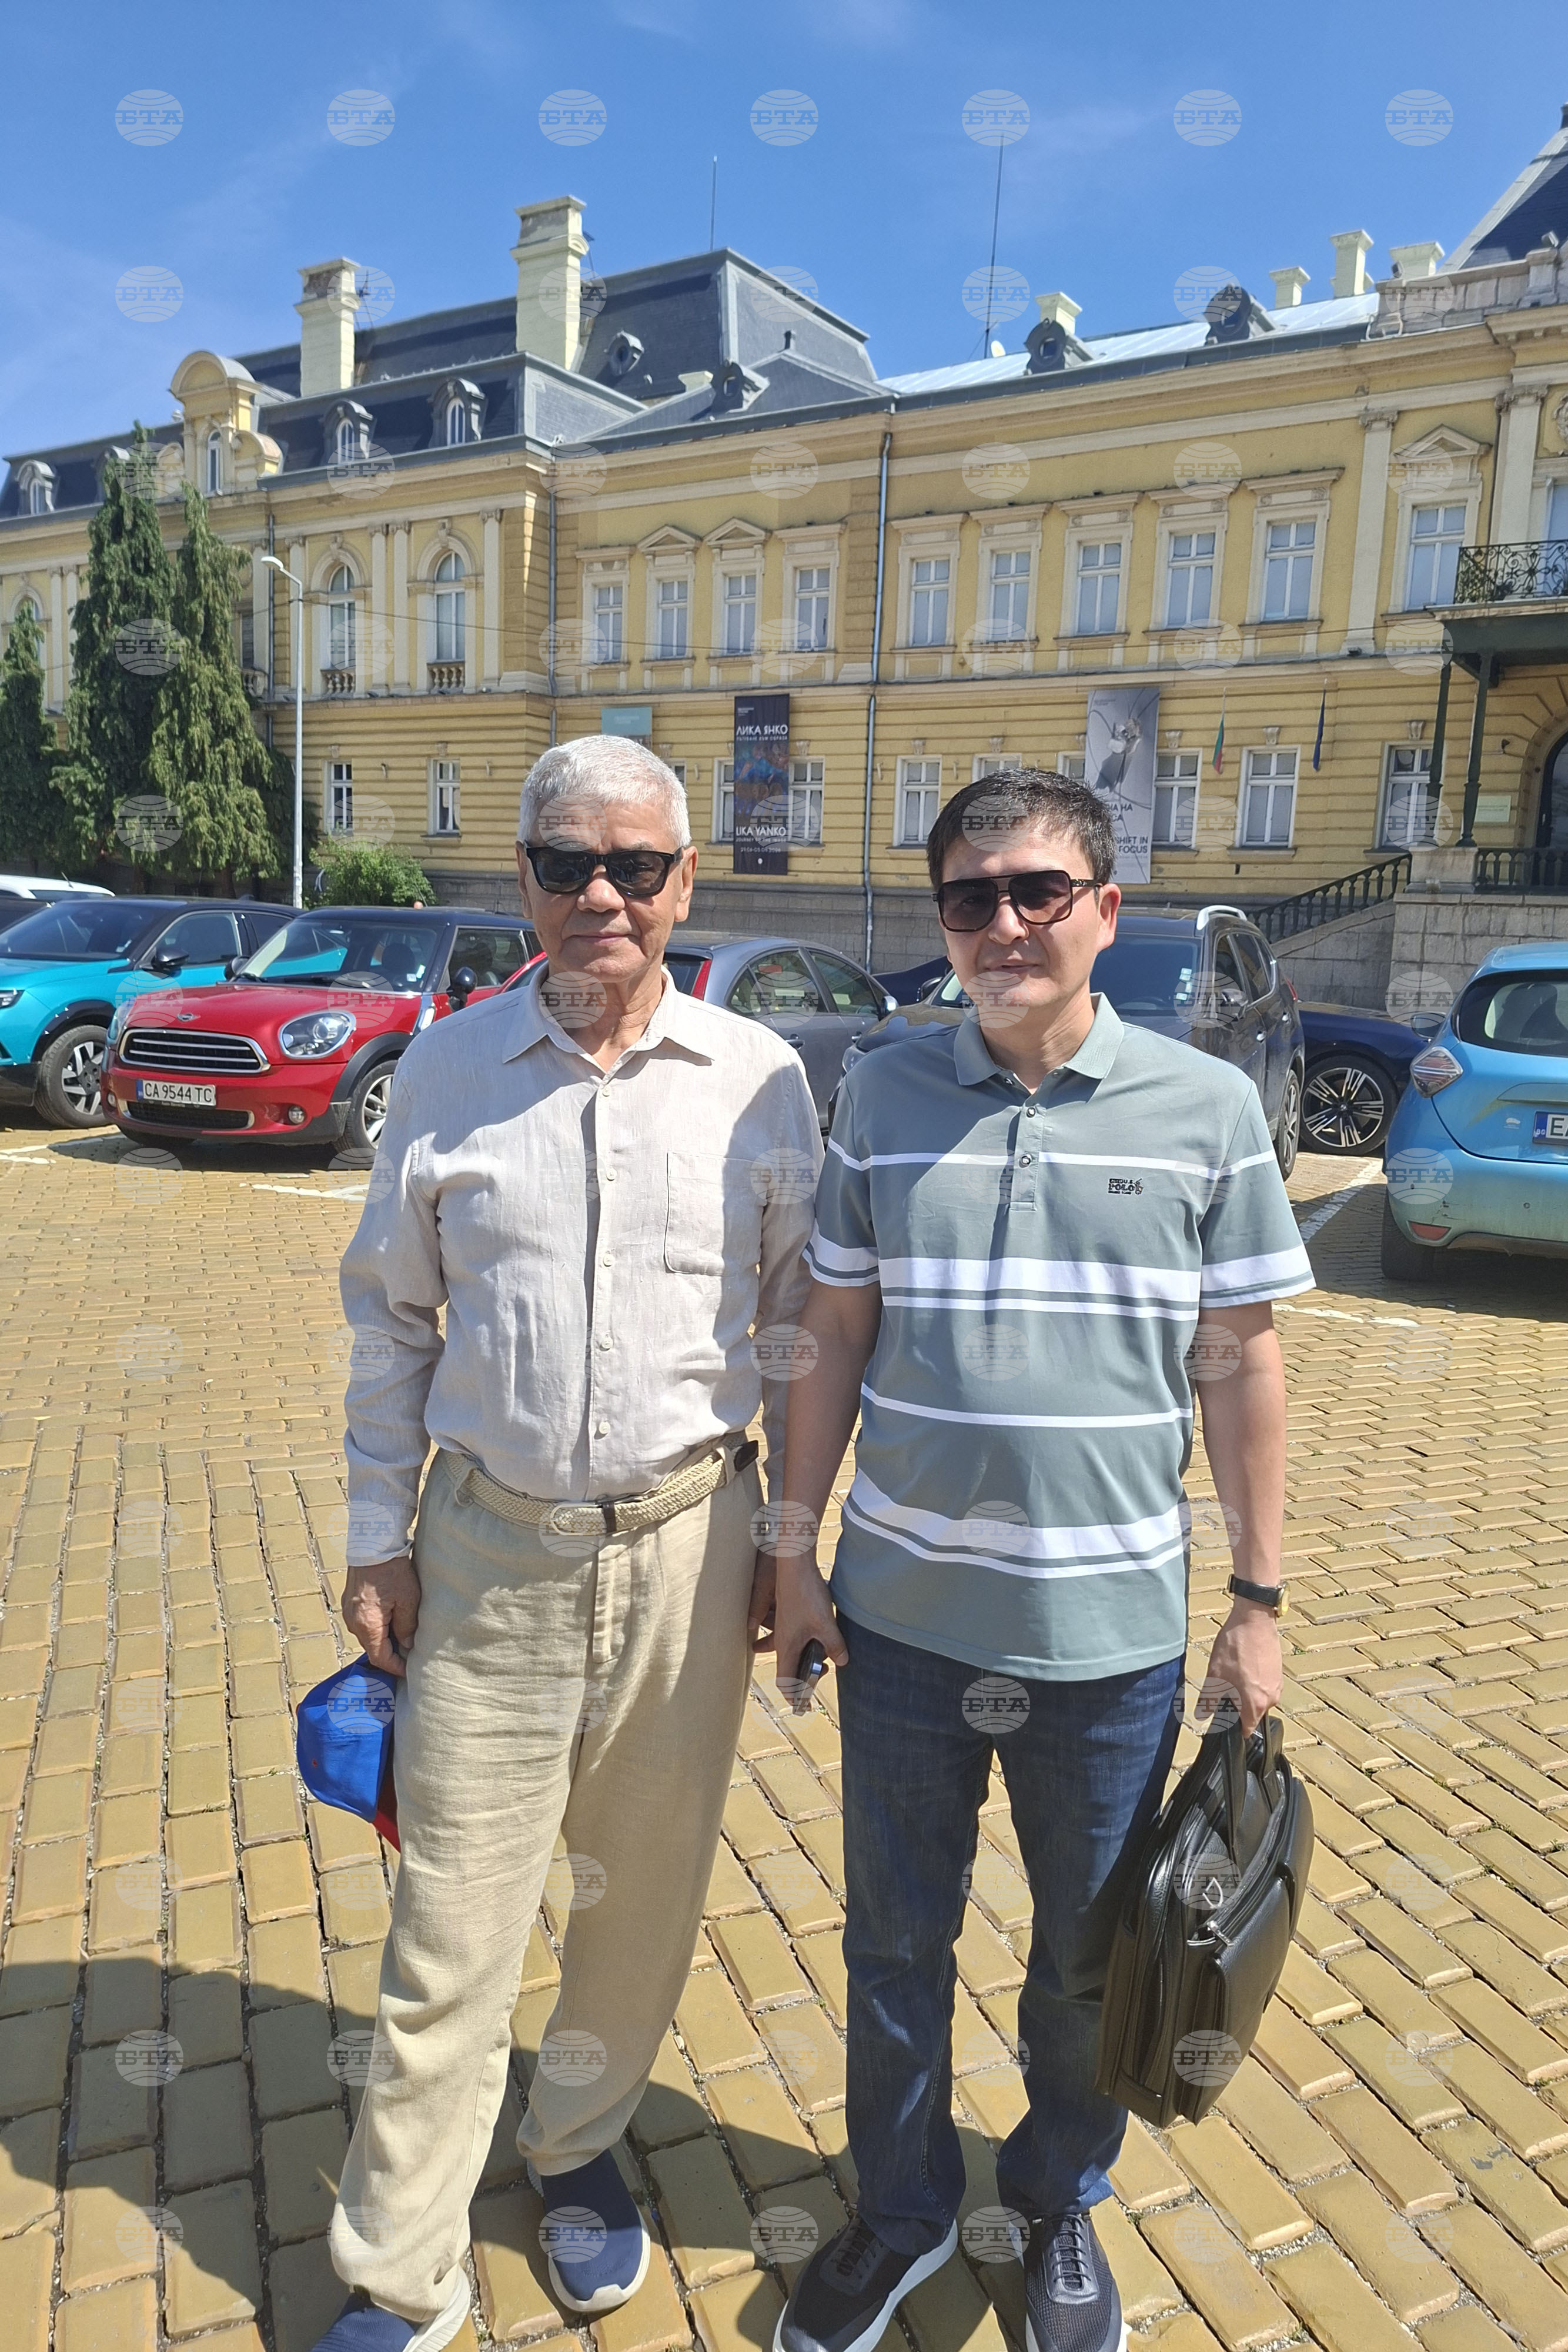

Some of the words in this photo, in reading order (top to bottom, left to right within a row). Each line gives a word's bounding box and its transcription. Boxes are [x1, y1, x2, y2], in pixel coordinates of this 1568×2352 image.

[736, 725, 762, 736] ЛИКА
[764, 724, 788, 735] ЯНКО
[755, 826, 787, 836] YANKO
[1116, 836, 1137, 844] SHIFT
[1139, 836, 1148, 844] IN
[1118, 845, 1148, 854] FOCUS
[145, 1083, 159, 1098] CA
[162, 1084, 192, 1101] 9544
[195, 1087, 212, 1102] TC
